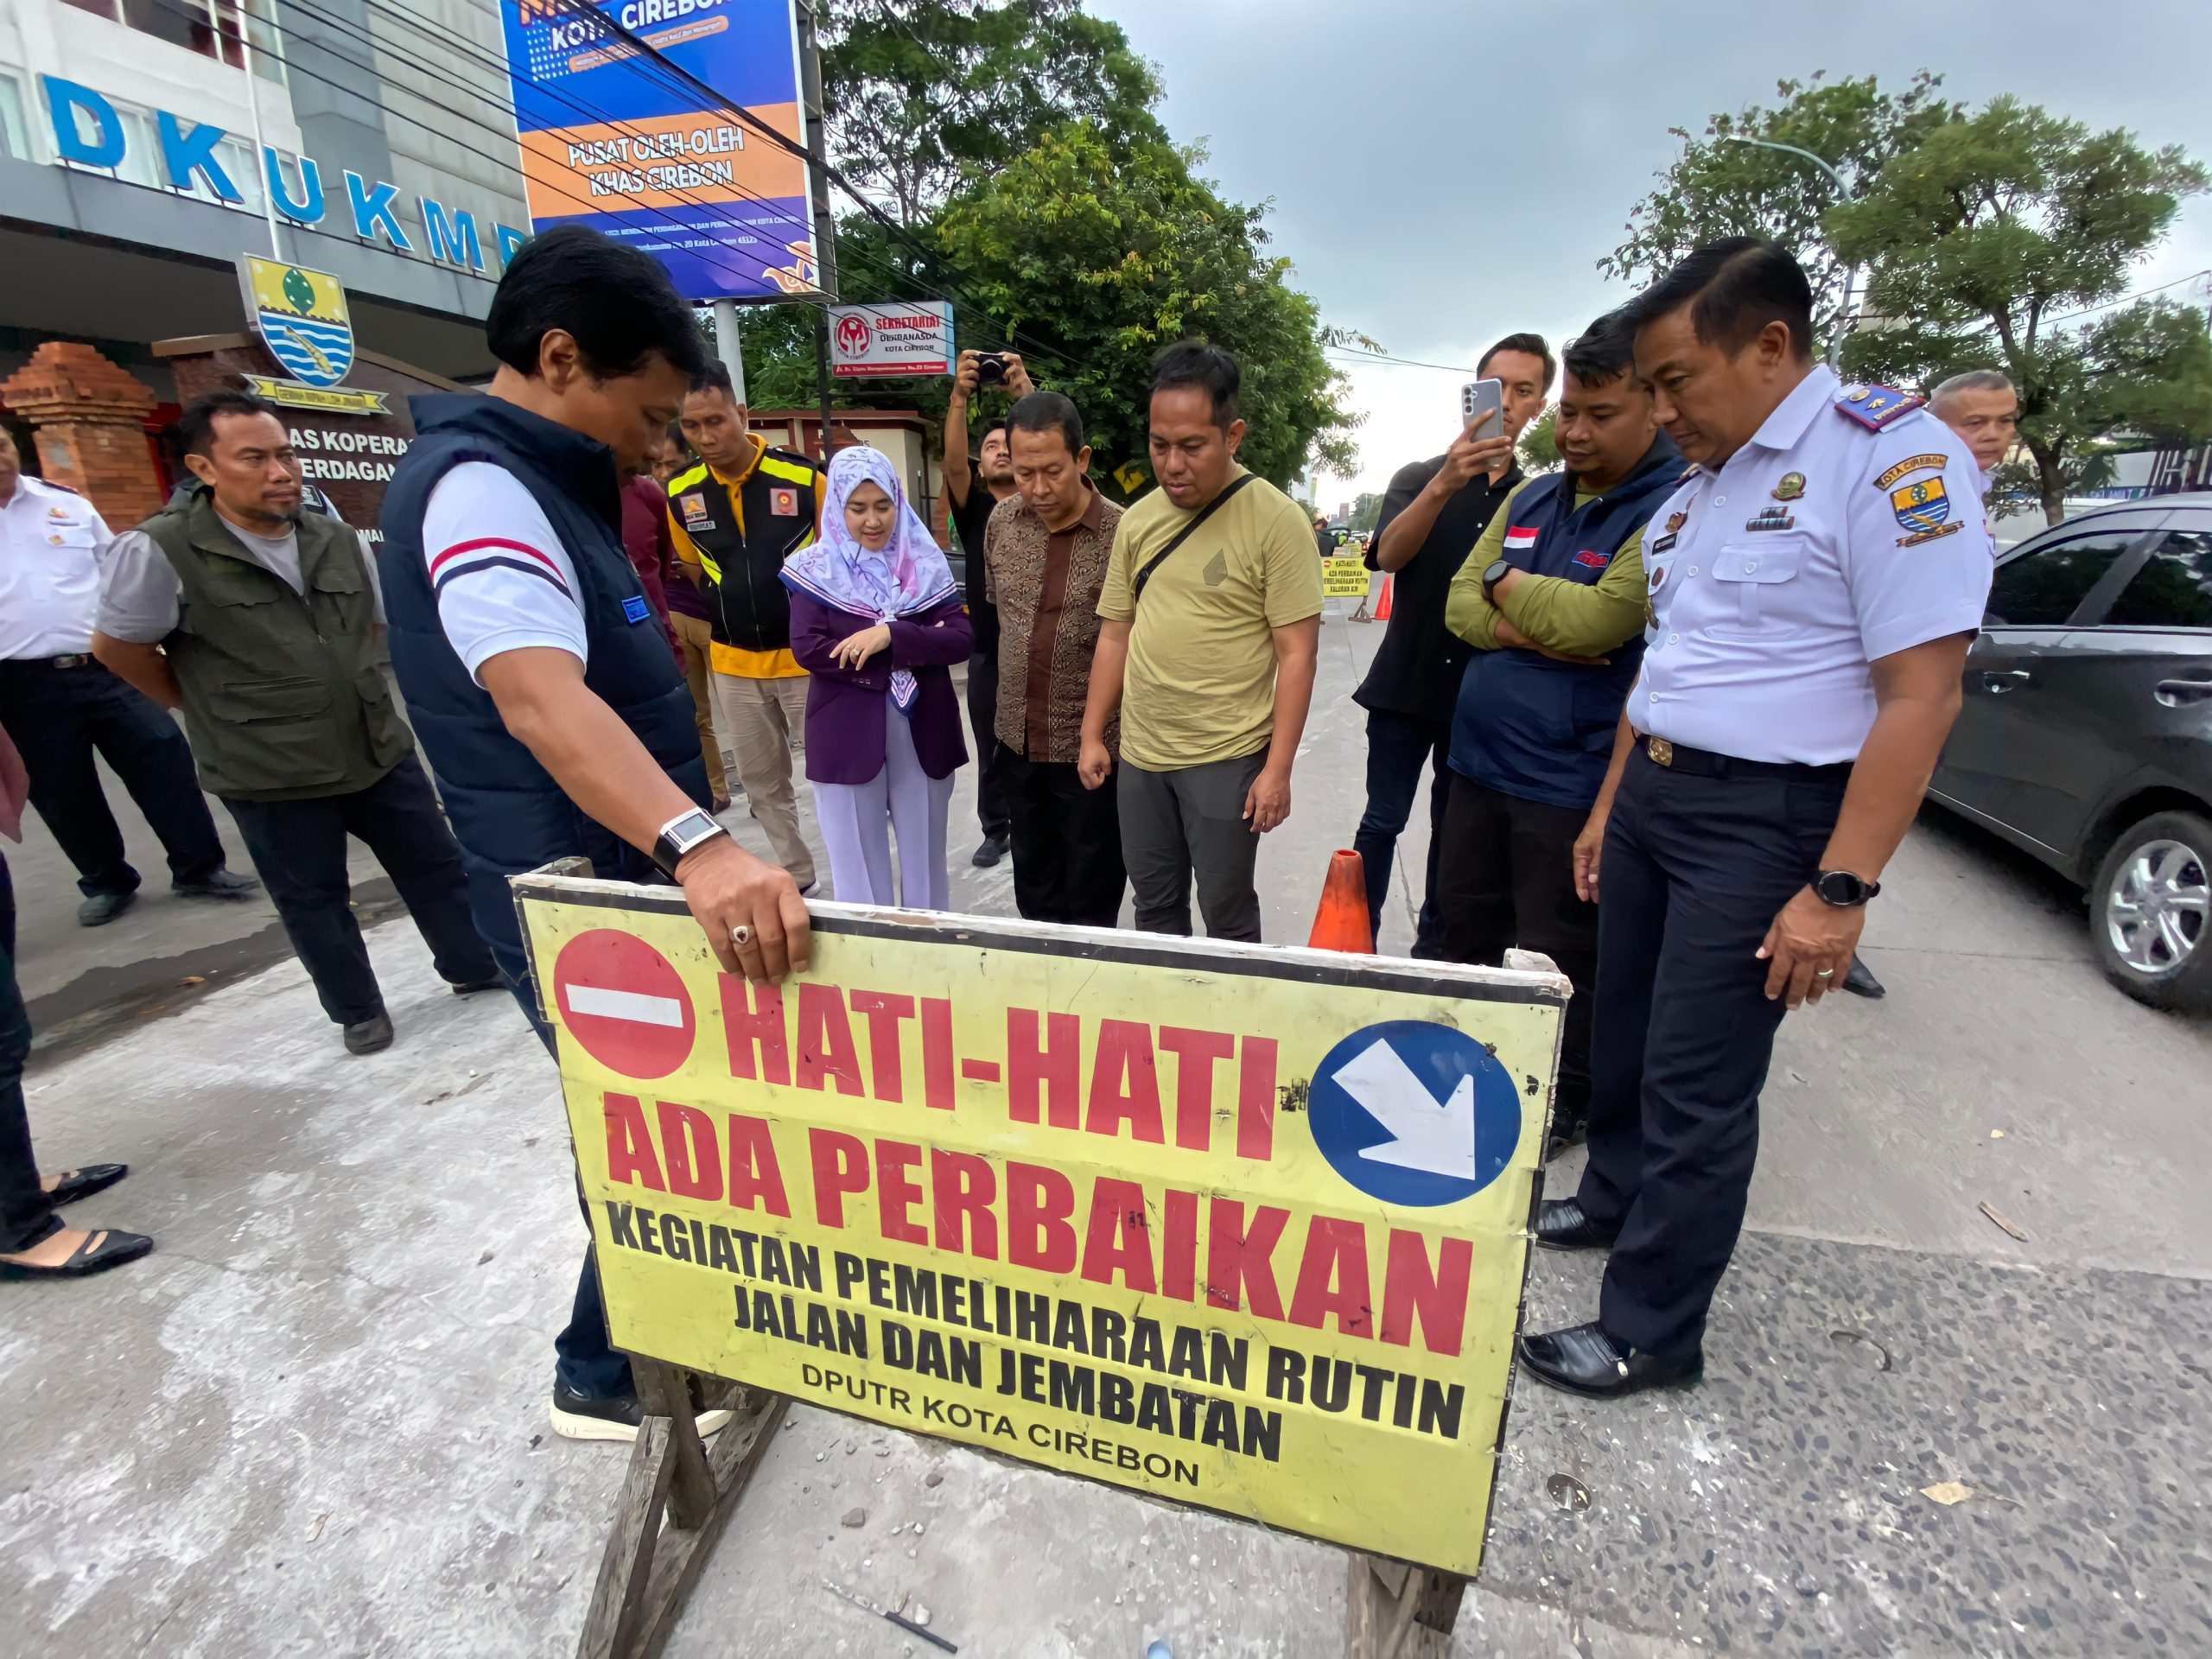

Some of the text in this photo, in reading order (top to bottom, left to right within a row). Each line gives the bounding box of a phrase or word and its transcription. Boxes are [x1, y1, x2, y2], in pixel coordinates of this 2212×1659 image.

[552, 11, 611, 51] KOT
[568, 125, 745, 168] PUSAT OLEH-OLEH
[589, 159, 734, 197] KHAS CIREBON
[875, 315, 941, 330] SEKRETARIAT
[904, 344, 935, 353] CIREBON
[289, 428, 414, 455] AS KOPERA
[299, 458, 396, 481] ERDAGA
[1880, 456, 1944, 488] KOTA CIREBON
[718, 972, 1278, 1161] HATI-HATI
[604, 1091, 1473, 1357] ADA PERBAIKAN
[606, 1200, 1465, 1440] KEGIATAN PEMELIHARAAN RUTIN
[734, 1285, 1282, 1463] JALAN DAN JEMBATAN
[802, 1363, 1199, 1487] DPUTR KOTA CIREBON
